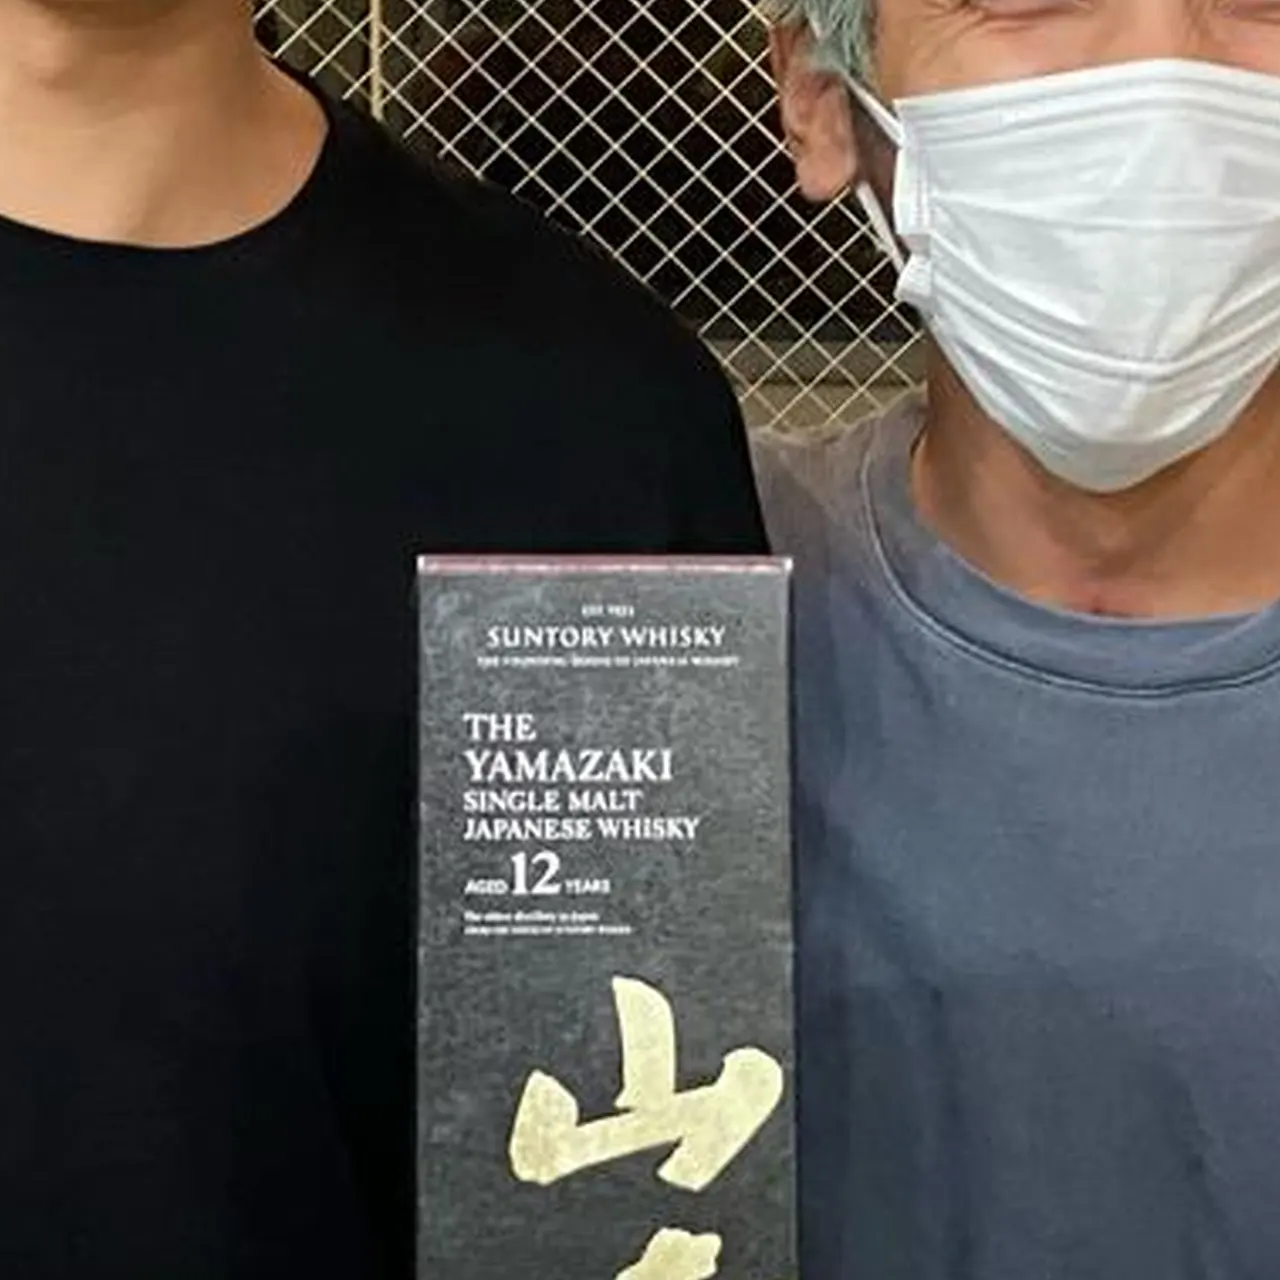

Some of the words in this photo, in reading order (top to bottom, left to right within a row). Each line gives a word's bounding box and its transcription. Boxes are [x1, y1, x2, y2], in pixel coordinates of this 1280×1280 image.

[486, 625, 614, 648] SUNTORY
[619, 625, 726, 648] WHISKY
[462, 712, 537, 742] THE
[462, 748, 673, 782] YAMAZAKI
[463, 789, 561, 812] SINGLE
[568, 789, 644, 812] MALT
[463, 817, 593, 840] JAPANESE
[595, 817, 700, 840] WHISKY
[464, 878, 509, 895] AGED
[510, 850, 562, 895] 12
[564, 878, 611, 895] YEARS
